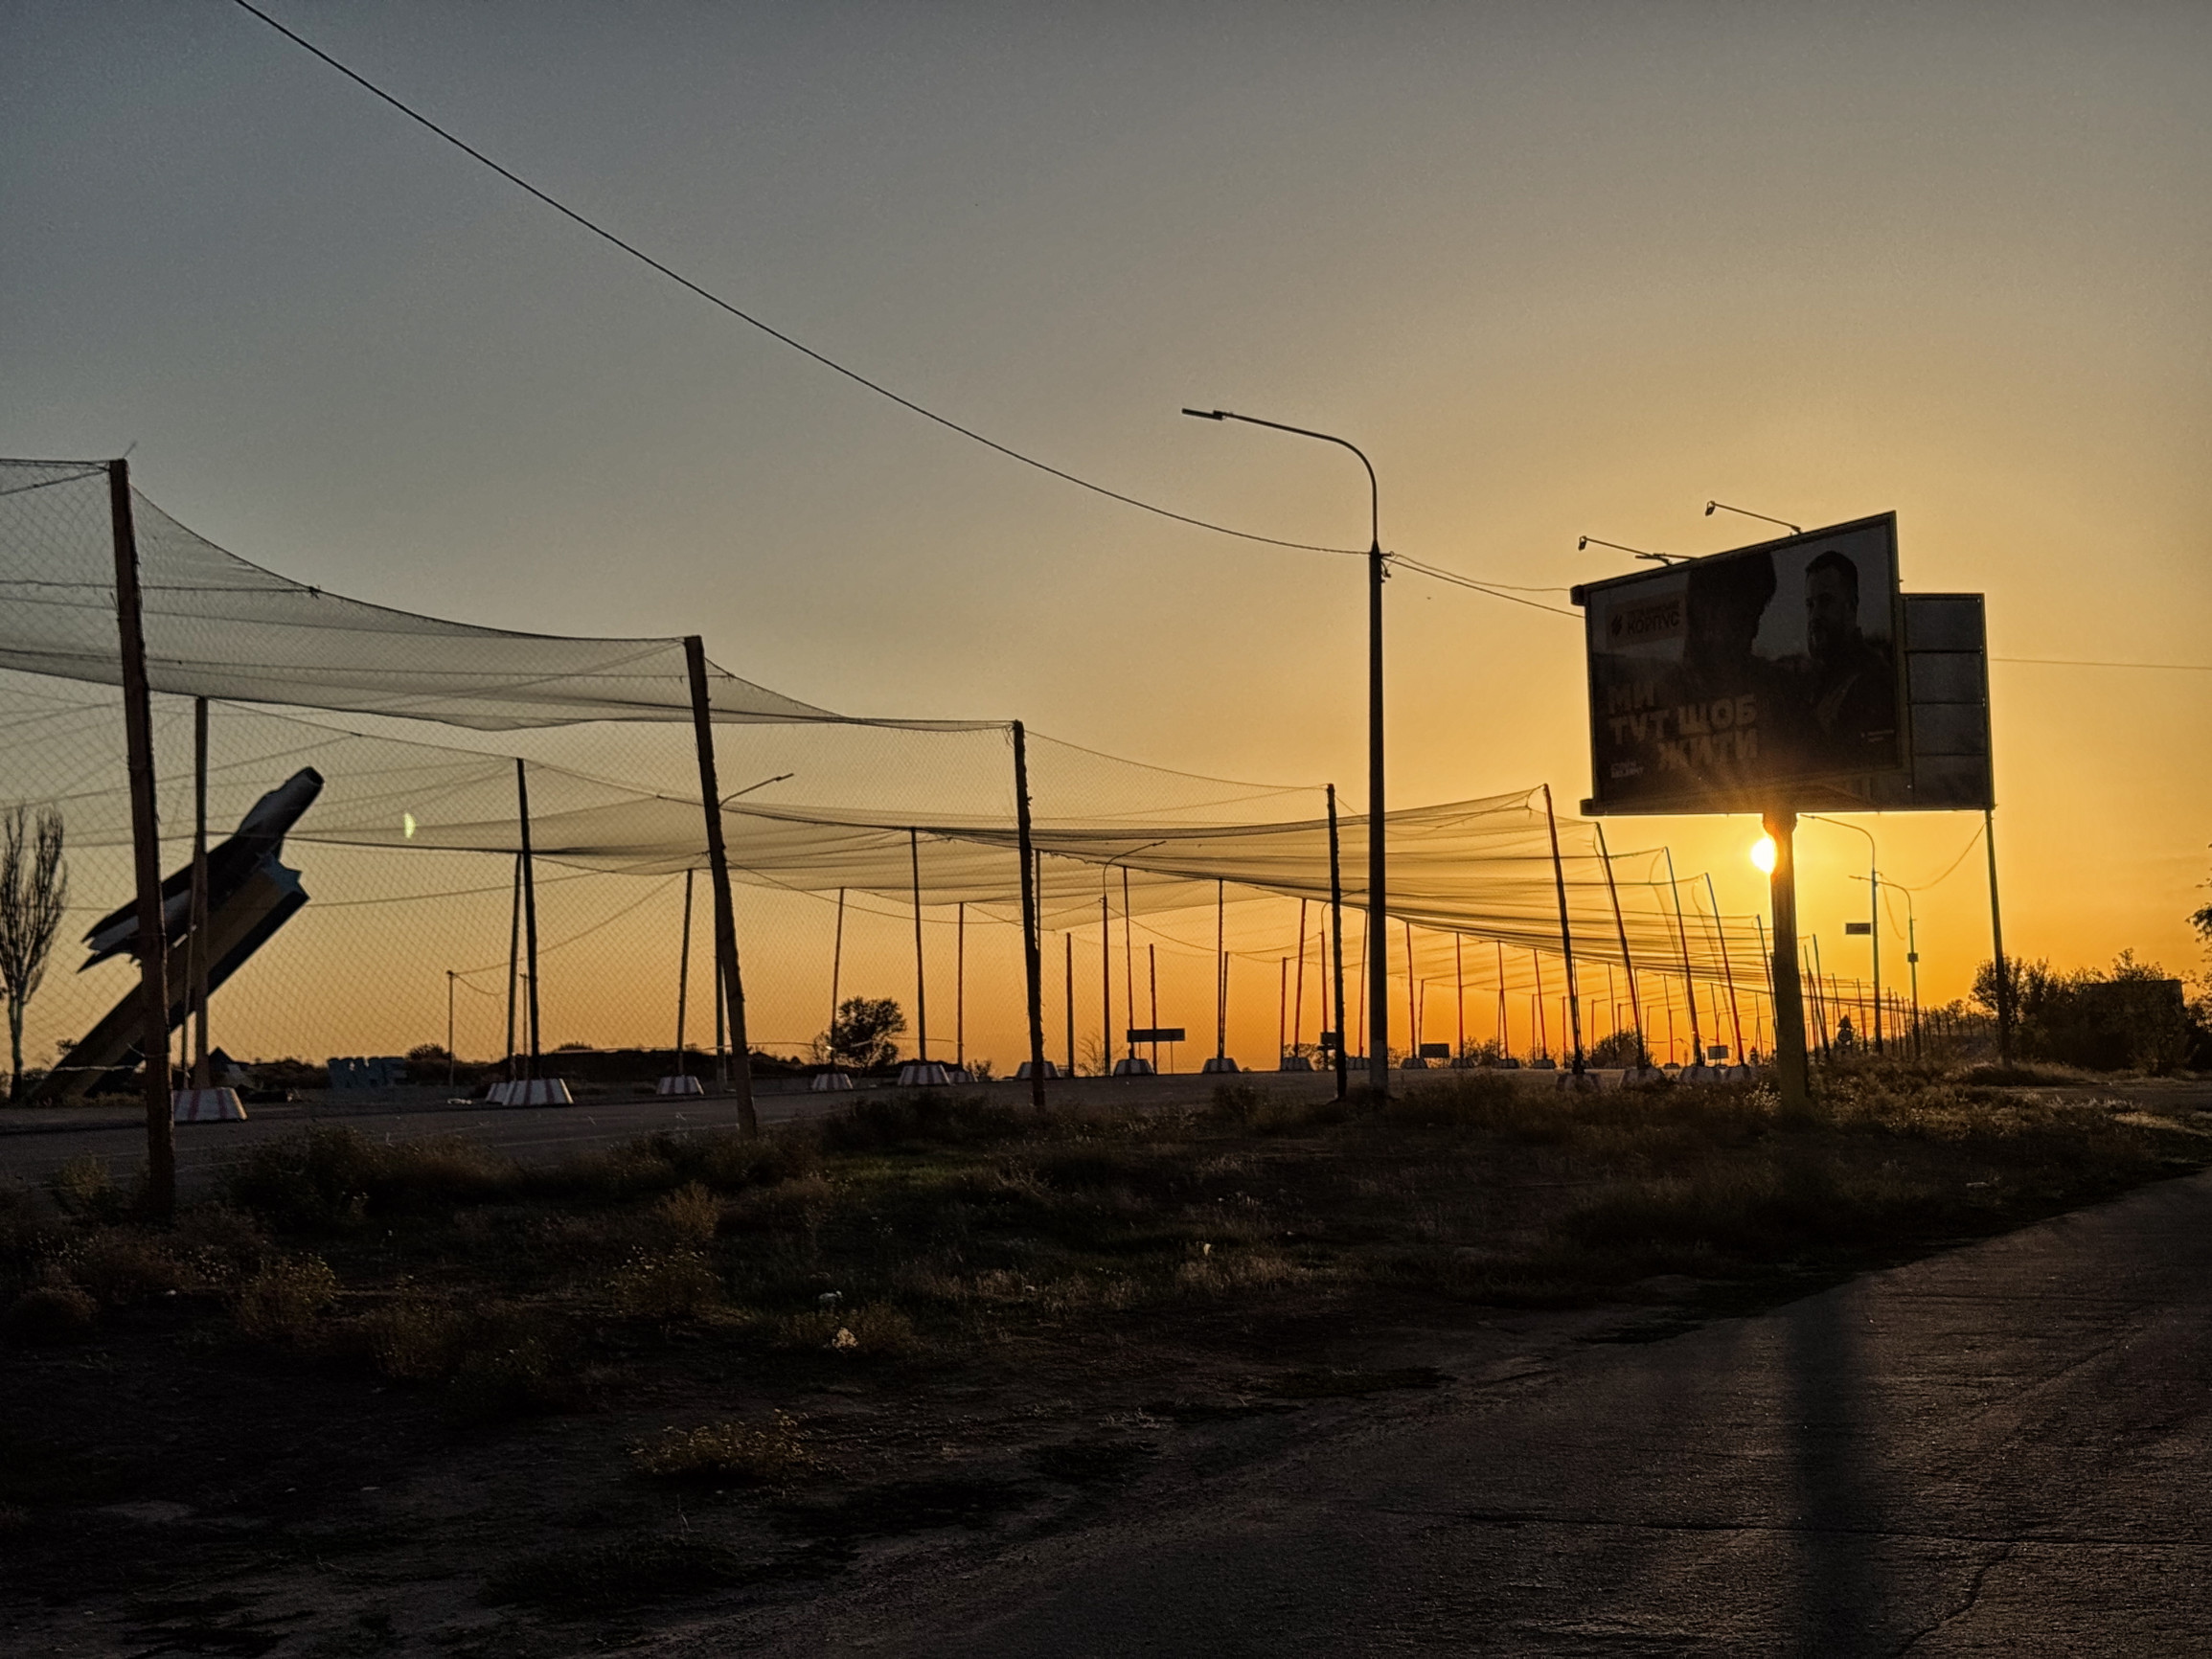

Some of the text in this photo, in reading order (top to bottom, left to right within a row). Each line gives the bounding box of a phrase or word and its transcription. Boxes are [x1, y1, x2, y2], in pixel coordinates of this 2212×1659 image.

[1628, 610, 1679, 634] КОРПУС
[1608, 693, 1757, 745] ТУТ ЩОБ
[1657, 728, 1758, 770] ЖИТИ
